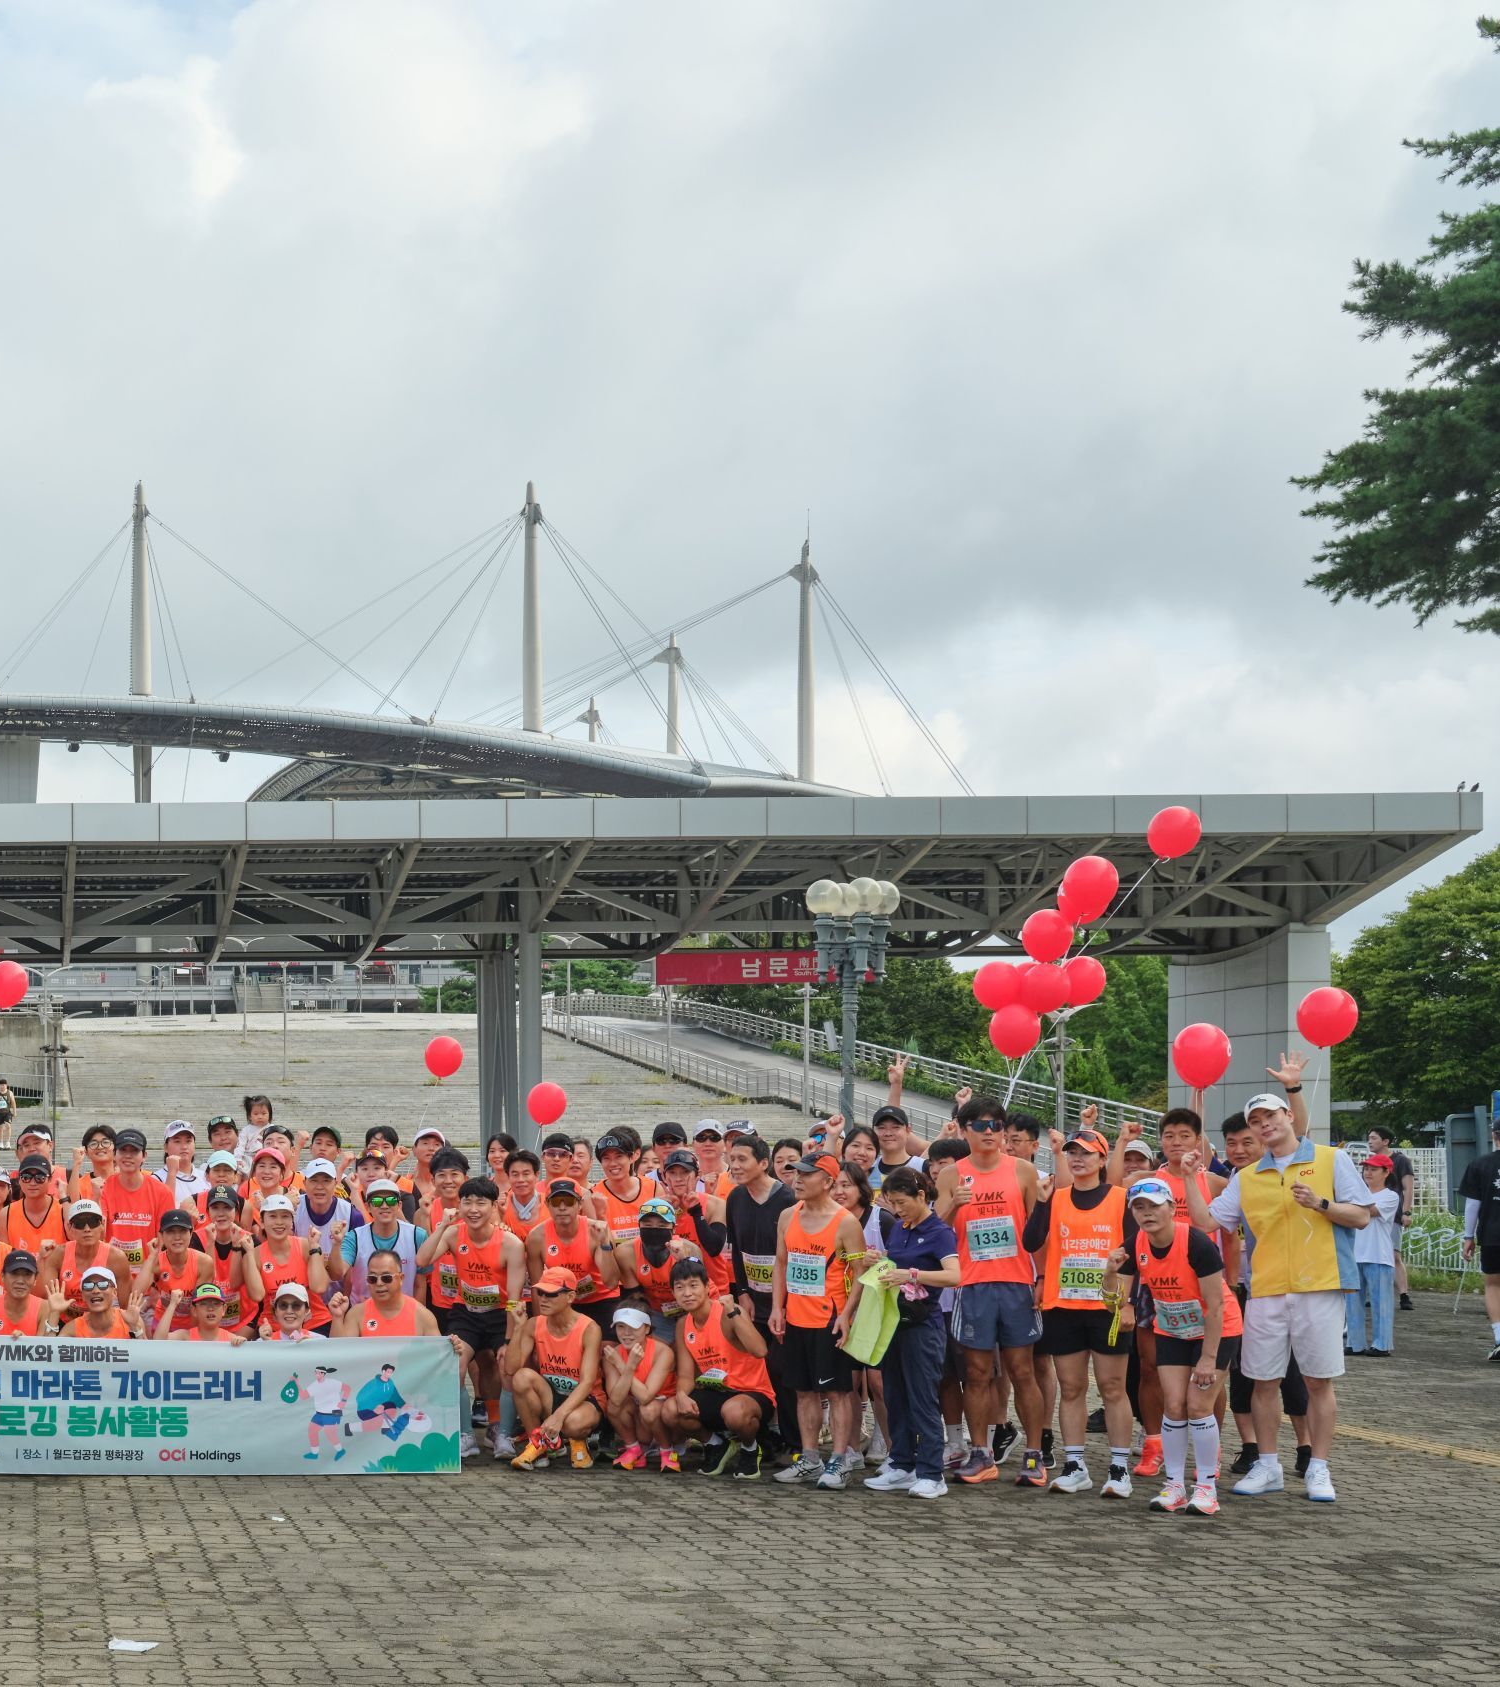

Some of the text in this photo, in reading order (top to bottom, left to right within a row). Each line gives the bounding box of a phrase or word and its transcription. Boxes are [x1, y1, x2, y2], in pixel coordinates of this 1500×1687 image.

[975, 1190, 1004, 1202] VMK
[1092, 1224, 1111, 1233] VMK
[974, 1230, 1009, 1246] 1334
[810, 1242, 826, 1253] VMK
[468, 1262, 491, 1273] VMK
[791, 1266, 818, 1281] 1335
[1061, 1271, 1103, 1284] 51083
[1150, 1276, 1179, 1287] VMK
[58, 1345, 130, 1363] 함께하는
[547, 1353, 567, 1365] VMK
[11, 1369, 102, 1401] 마라톤
[111, 1370, 262, 1401] 가이드러너
[67, 1405, 188, 1438] 봉사활동
[22, 1448, 144, 1461] 장소 월드컵공원 평화광장
[189, 1448, 241, 1463] Holdings
